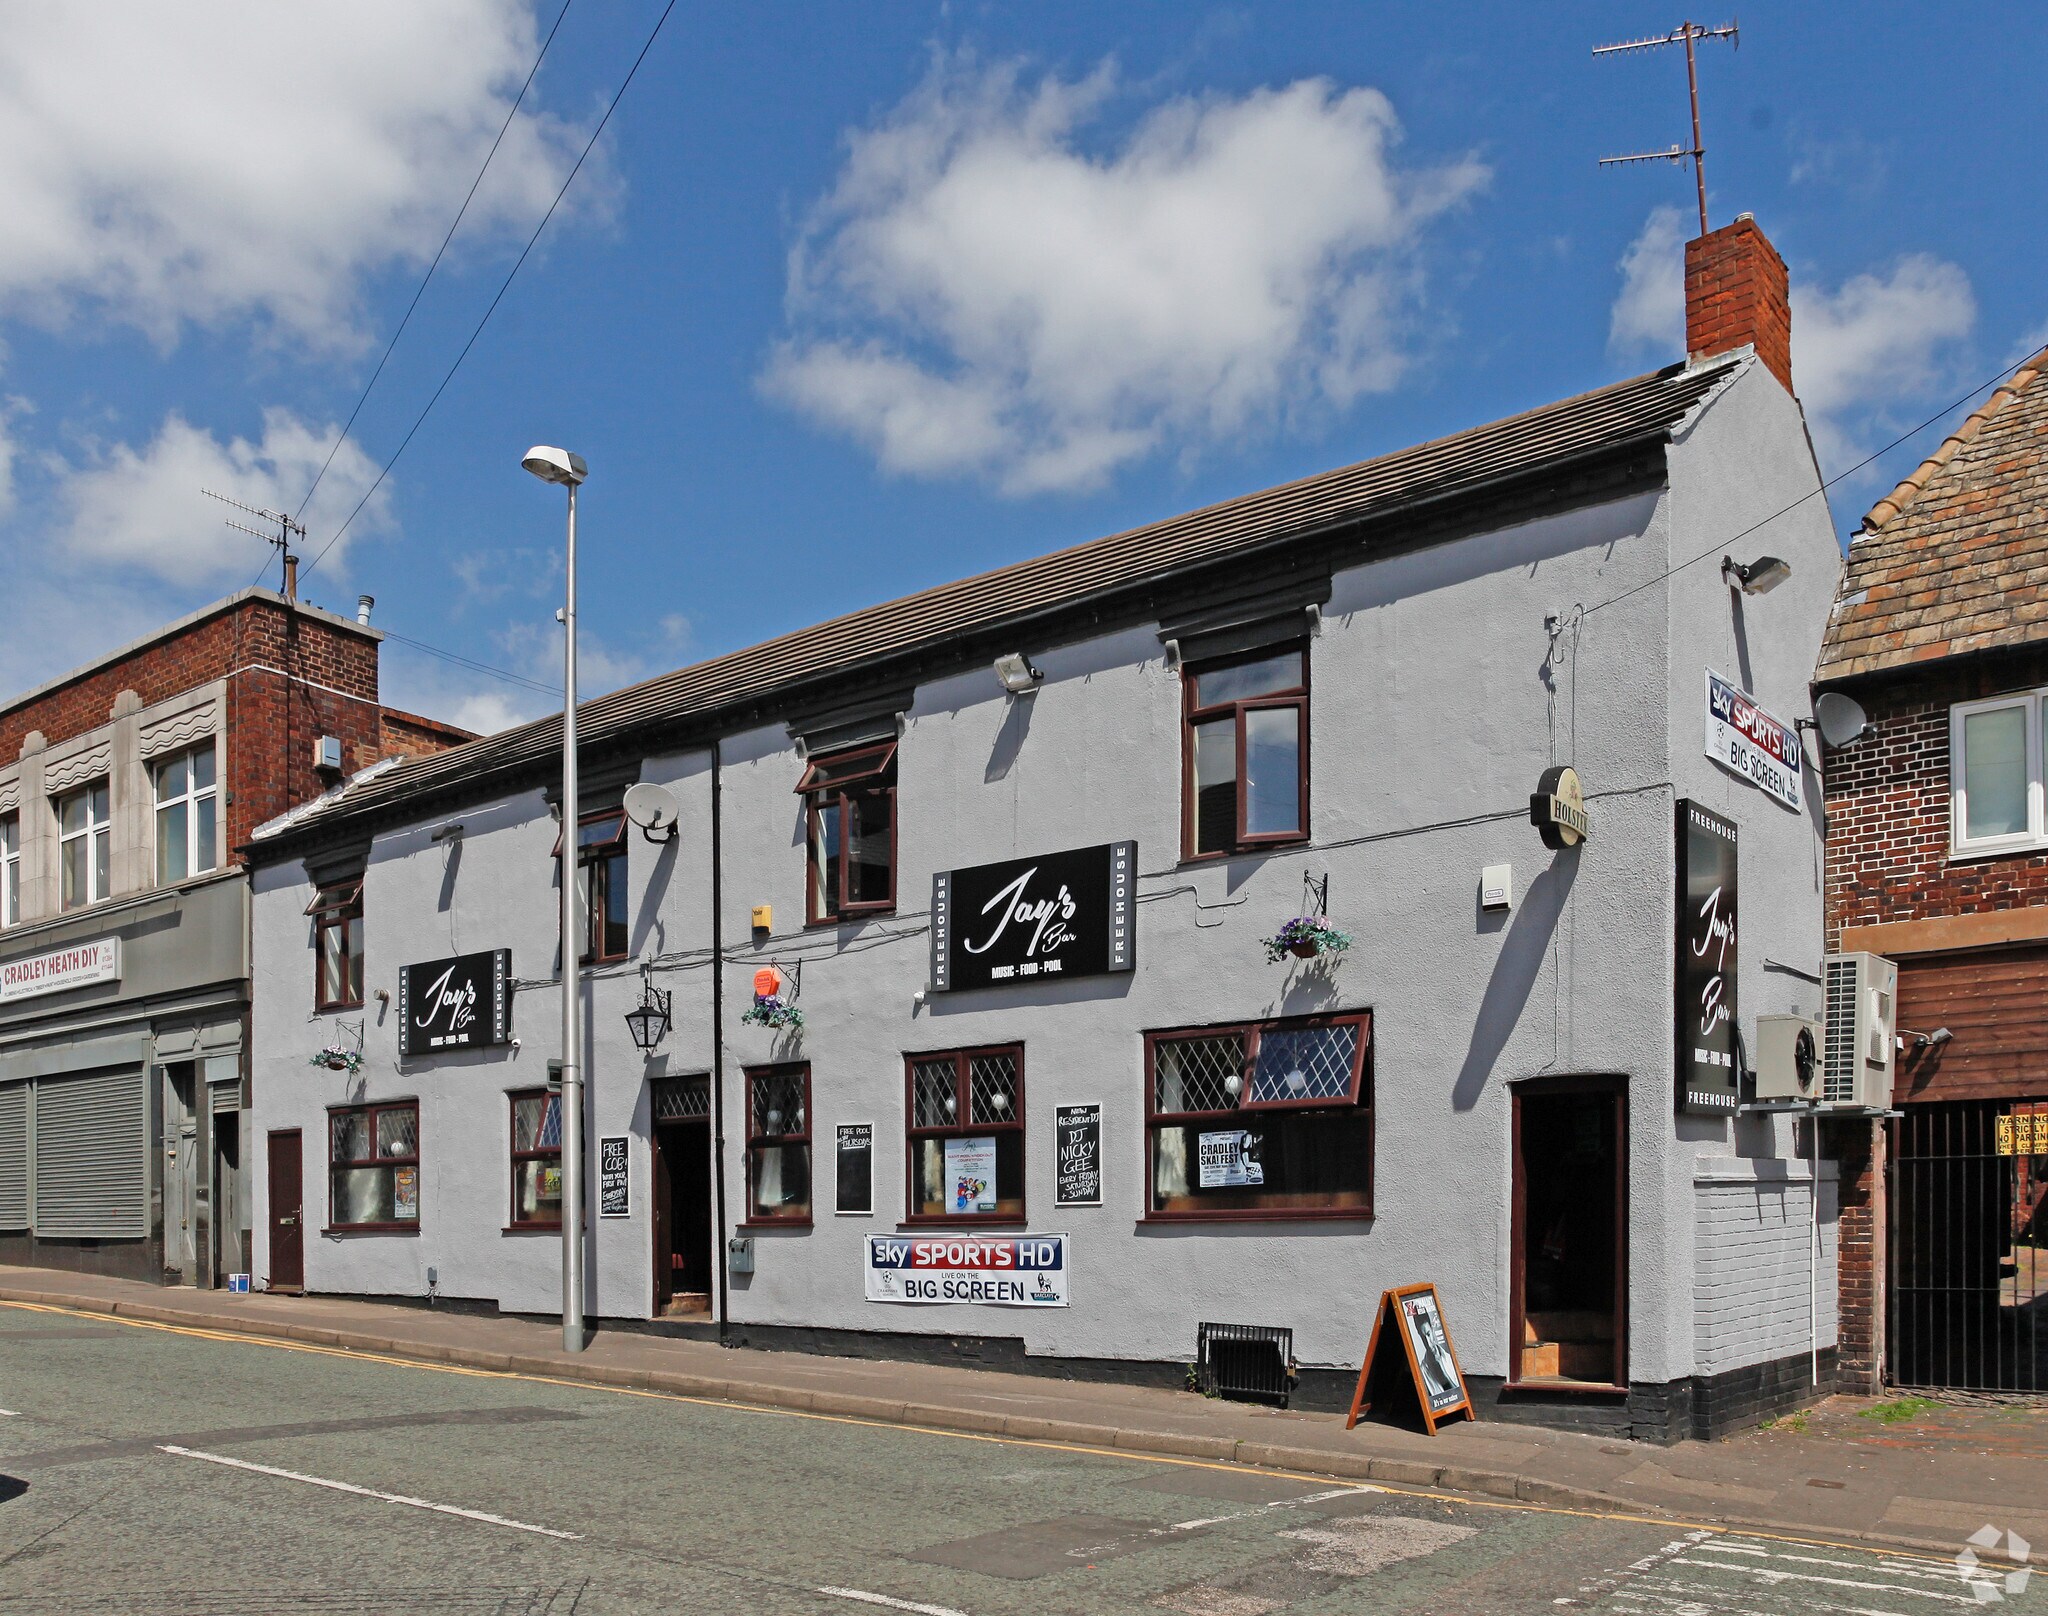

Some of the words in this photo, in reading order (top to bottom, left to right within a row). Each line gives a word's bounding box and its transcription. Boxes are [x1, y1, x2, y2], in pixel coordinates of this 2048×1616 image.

[1712, 685, 1732, 723] sky
[1734, 702, 1781, 755] SPORTS
[1782, 736, 1798, 767] HD
[1730, 741, 1748, 772] BIG
[1750, 754, 1786, 797] SCREEN
[1690, 808, 1736, 842] FREEHOUSE
[964, 866, 1077, 956] Jay's
[1115, 847, 1126, 964] FREEHOUSE
[936, 878, 946, 986] FREEHOUSE
[1042, 922, 1077, 953] Bar
[1692, 886, 1735, 973] Jay's
[4, 959, 46, 986] CRADLEY
[48, 951, 79, 976] HEATH
[82, 946, 98, 968] DIY
[992, 965, 1014, 980] MUSIC
[1020, 962, 1038, 976] FOOD
[1044, 959, 1062, 972] POOL
[416, 964, 477, 1031] Jay's
[1701, 975, 1730, 1036] Bar
[1688, 1090, 1736, 1108] FREEHOUSE
[1058, 1115, 1090, 1126] RESIDENT
[1090, 1112, 1099, 1122] DJ
[840, 1128, 854, 1136] FREE
[1069, 1128, 1088, 1145] DJ
[603, 1142, 624, 1157] FREE
[1060, 1140, 1096, 1161] NICKY
[1201, 1143, 1239, 1155] CRADLEY
[1201, 1155, 1219, 1165] SKA!
[1220, 1154, 1239, 1164] FEST
[605, 1157, 627, 1170] COB!
[1064, 1155, 1093, 1174] GEE
[1065, 1180, 1098, 1191] SATURDAY
[1069, 1187, 1095, 1199] SUNDAY
[875, 1241, 909, 1268] sky
[915, 1243, 1012, 1266] SPORTS
[1019, 1242, 1055, 1267] HD
[905, 1280, 937, 1299] BIG
[943, 1281, 1024, 1301] SCREEN
